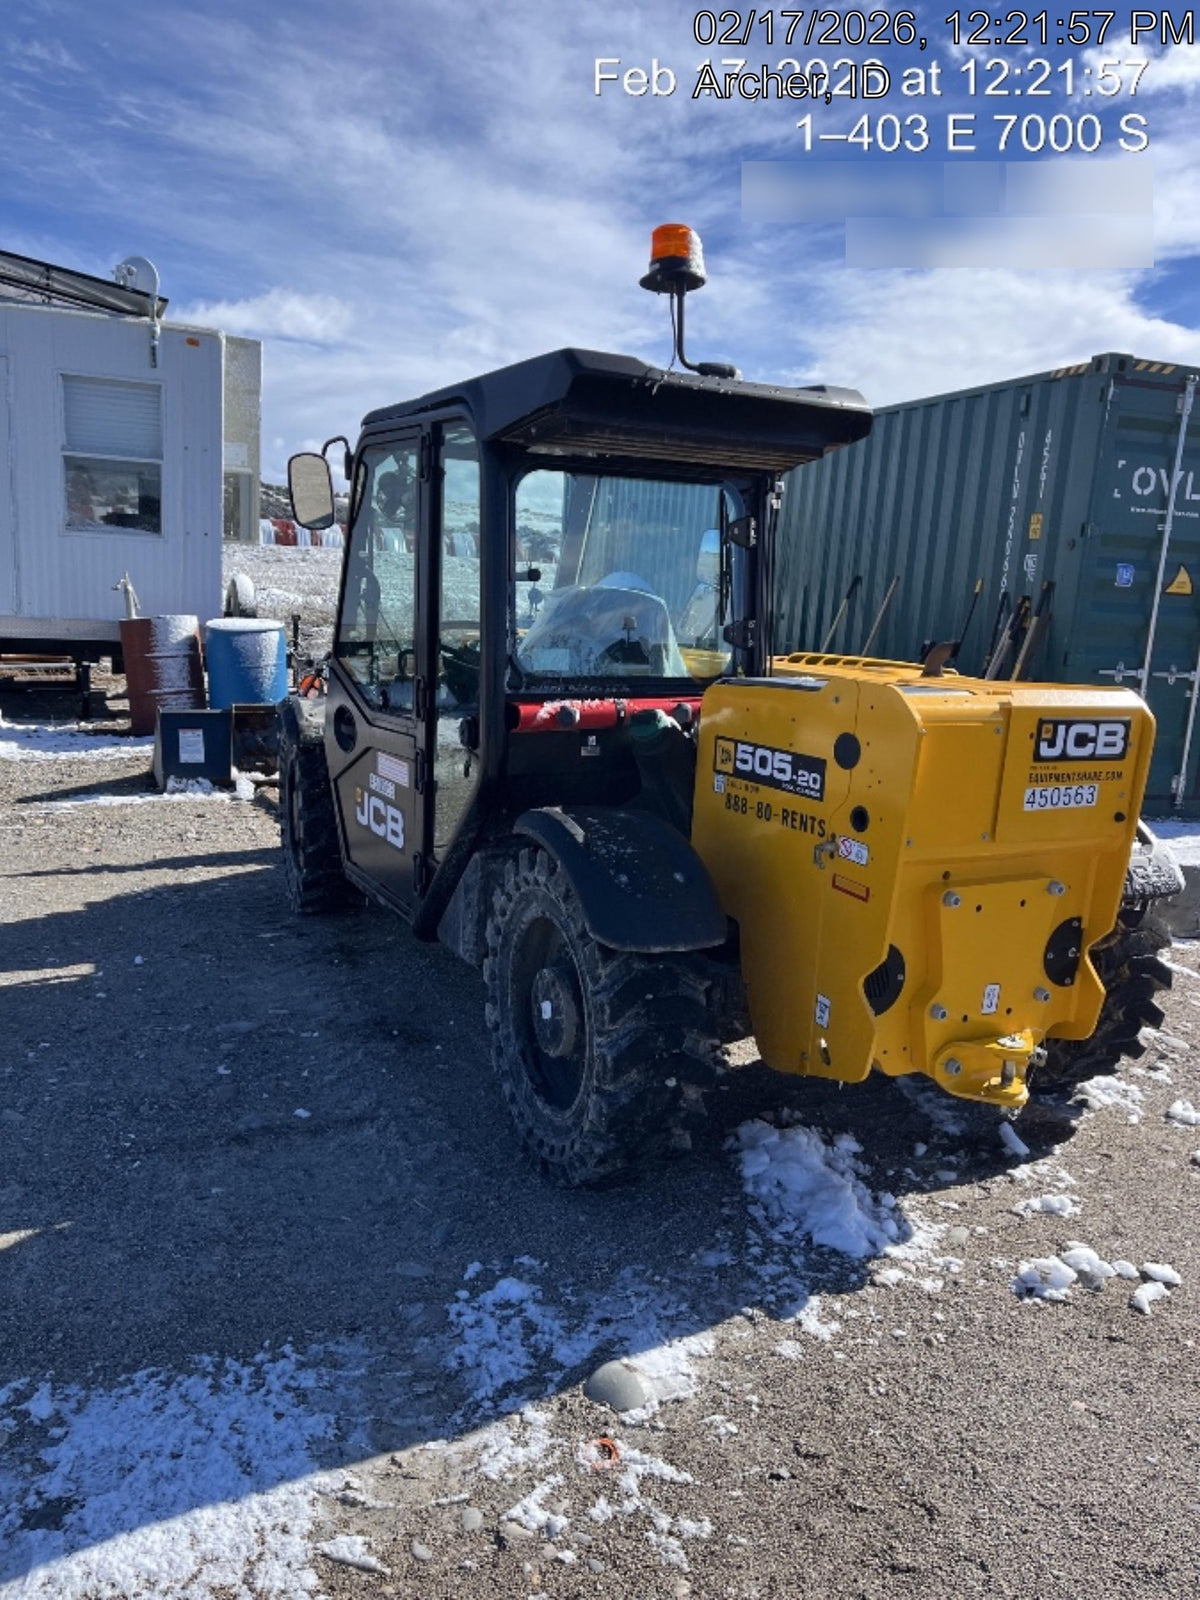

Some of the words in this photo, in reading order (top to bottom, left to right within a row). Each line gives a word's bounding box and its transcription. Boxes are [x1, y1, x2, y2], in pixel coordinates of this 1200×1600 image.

[1040, 722, 1126, 757] JCB
[725, 792, 826, 838] 888-80-RENTS
[1025, 785, 1096, 808] 450563
[357, 790, 405, 849] JCB
